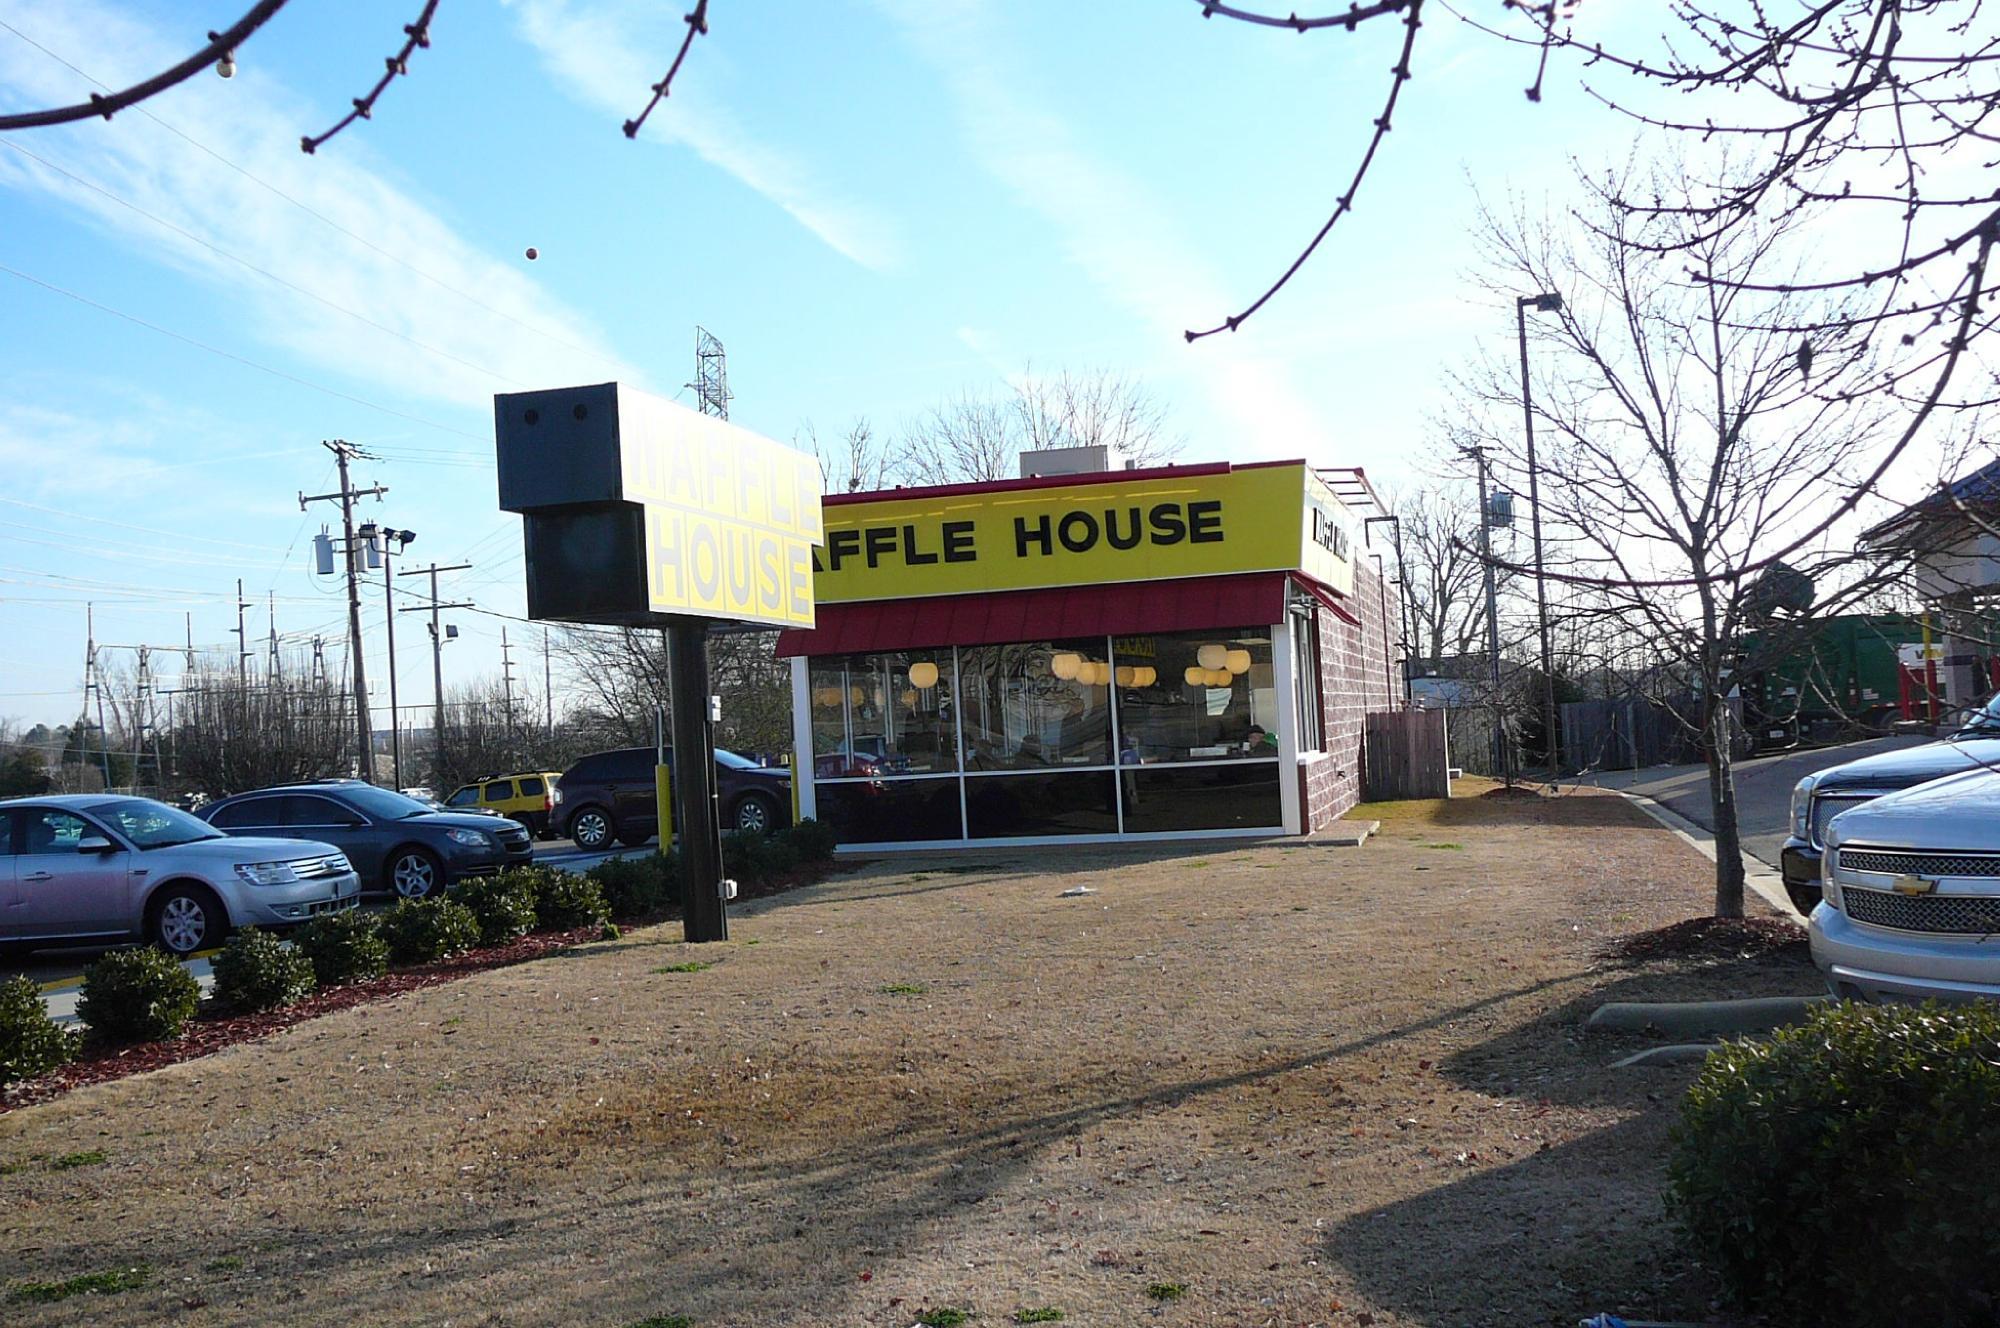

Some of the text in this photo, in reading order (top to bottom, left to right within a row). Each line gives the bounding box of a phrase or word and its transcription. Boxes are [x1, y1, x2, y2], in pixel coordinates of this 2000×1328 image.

[625, 408, 818, 533] WAFFLE
[652, 510, 810, 614] HOUSE
[1014, 500, 1224, 557] HOUSE
